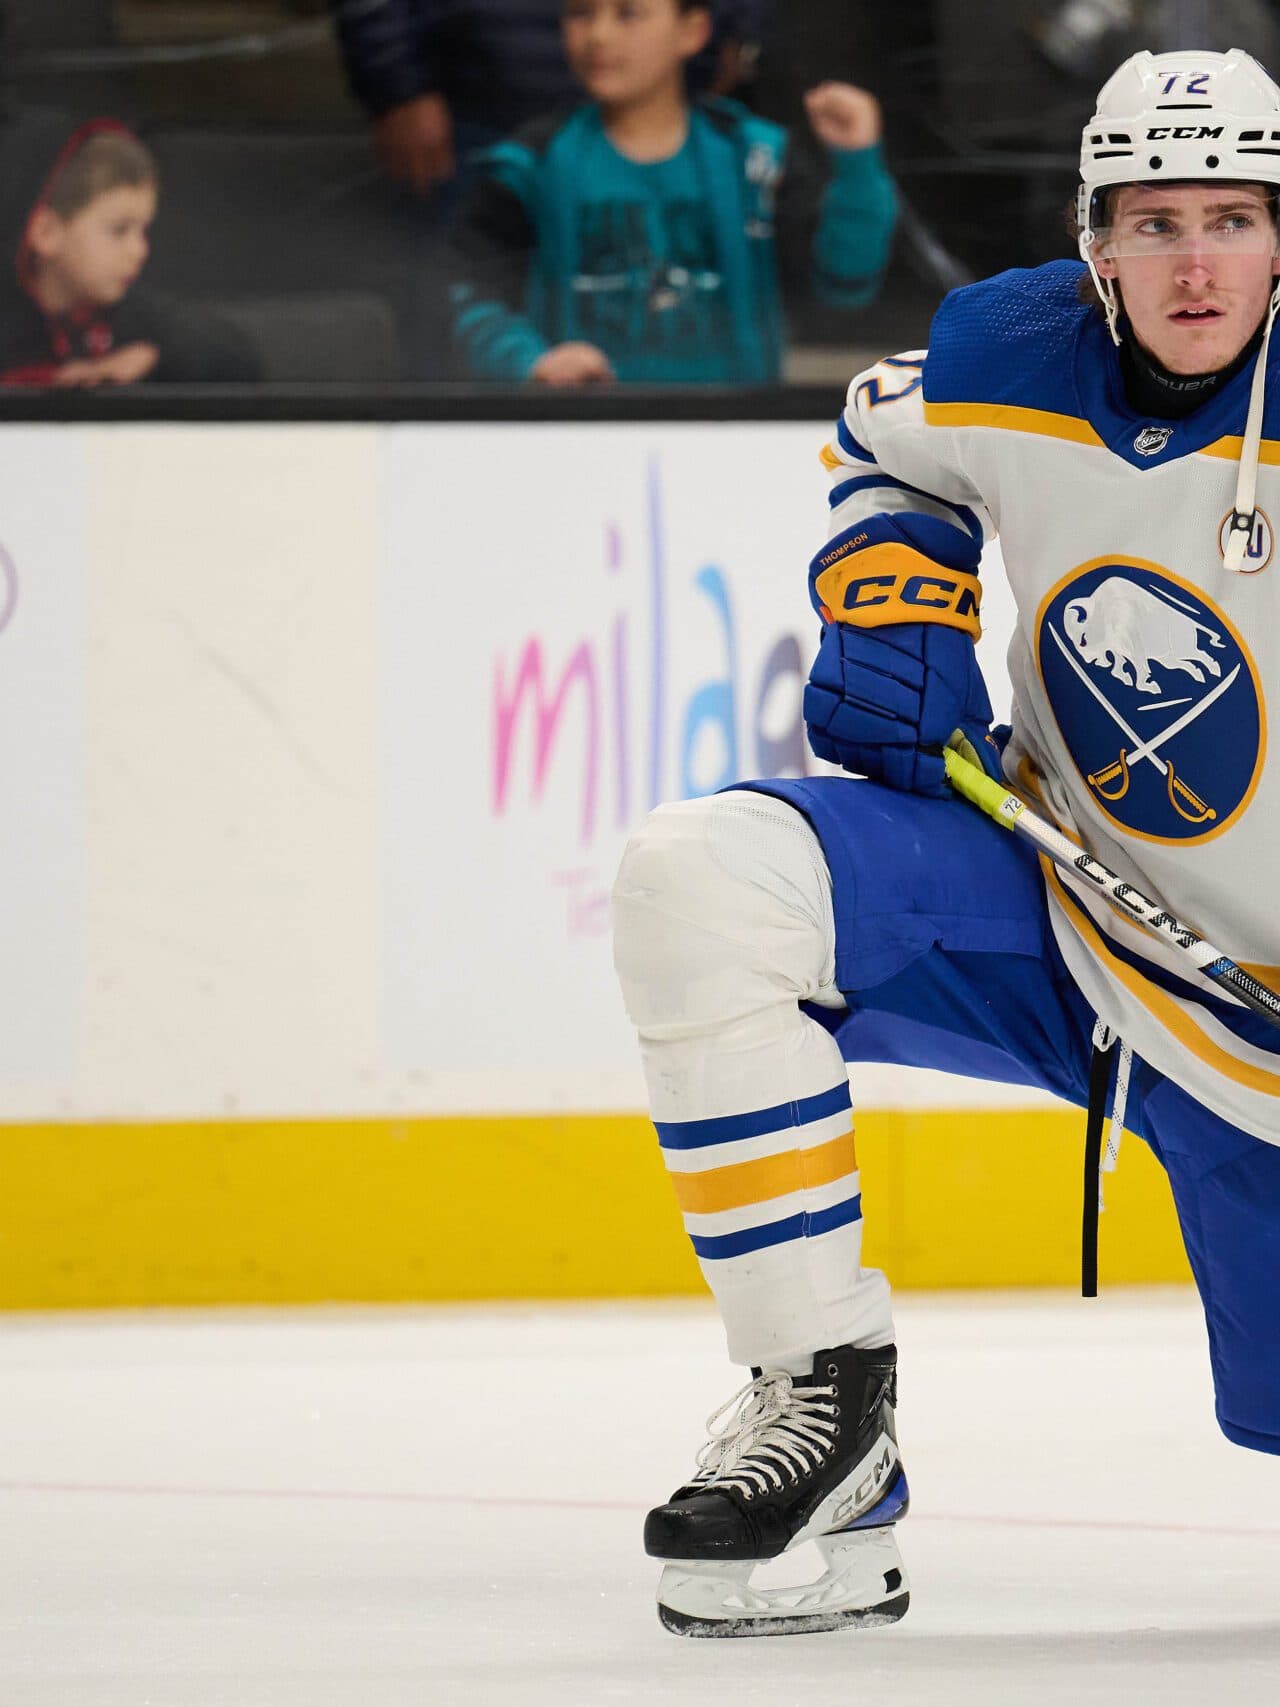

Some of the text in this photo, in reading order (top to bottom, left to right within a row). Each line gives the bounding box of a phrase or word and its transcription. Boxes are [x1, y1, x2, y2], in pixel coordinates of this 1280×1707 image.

[1157, 71, 1211, 95] 72
[1146, 126, 1225, 140] CCM
[820, 532, 869, 567] THOMPSON
[1004, 798, 1022, 814] 72
[1073, 853, 1204, 949] CCM
[832, 1447, 890, 1524] CCM
